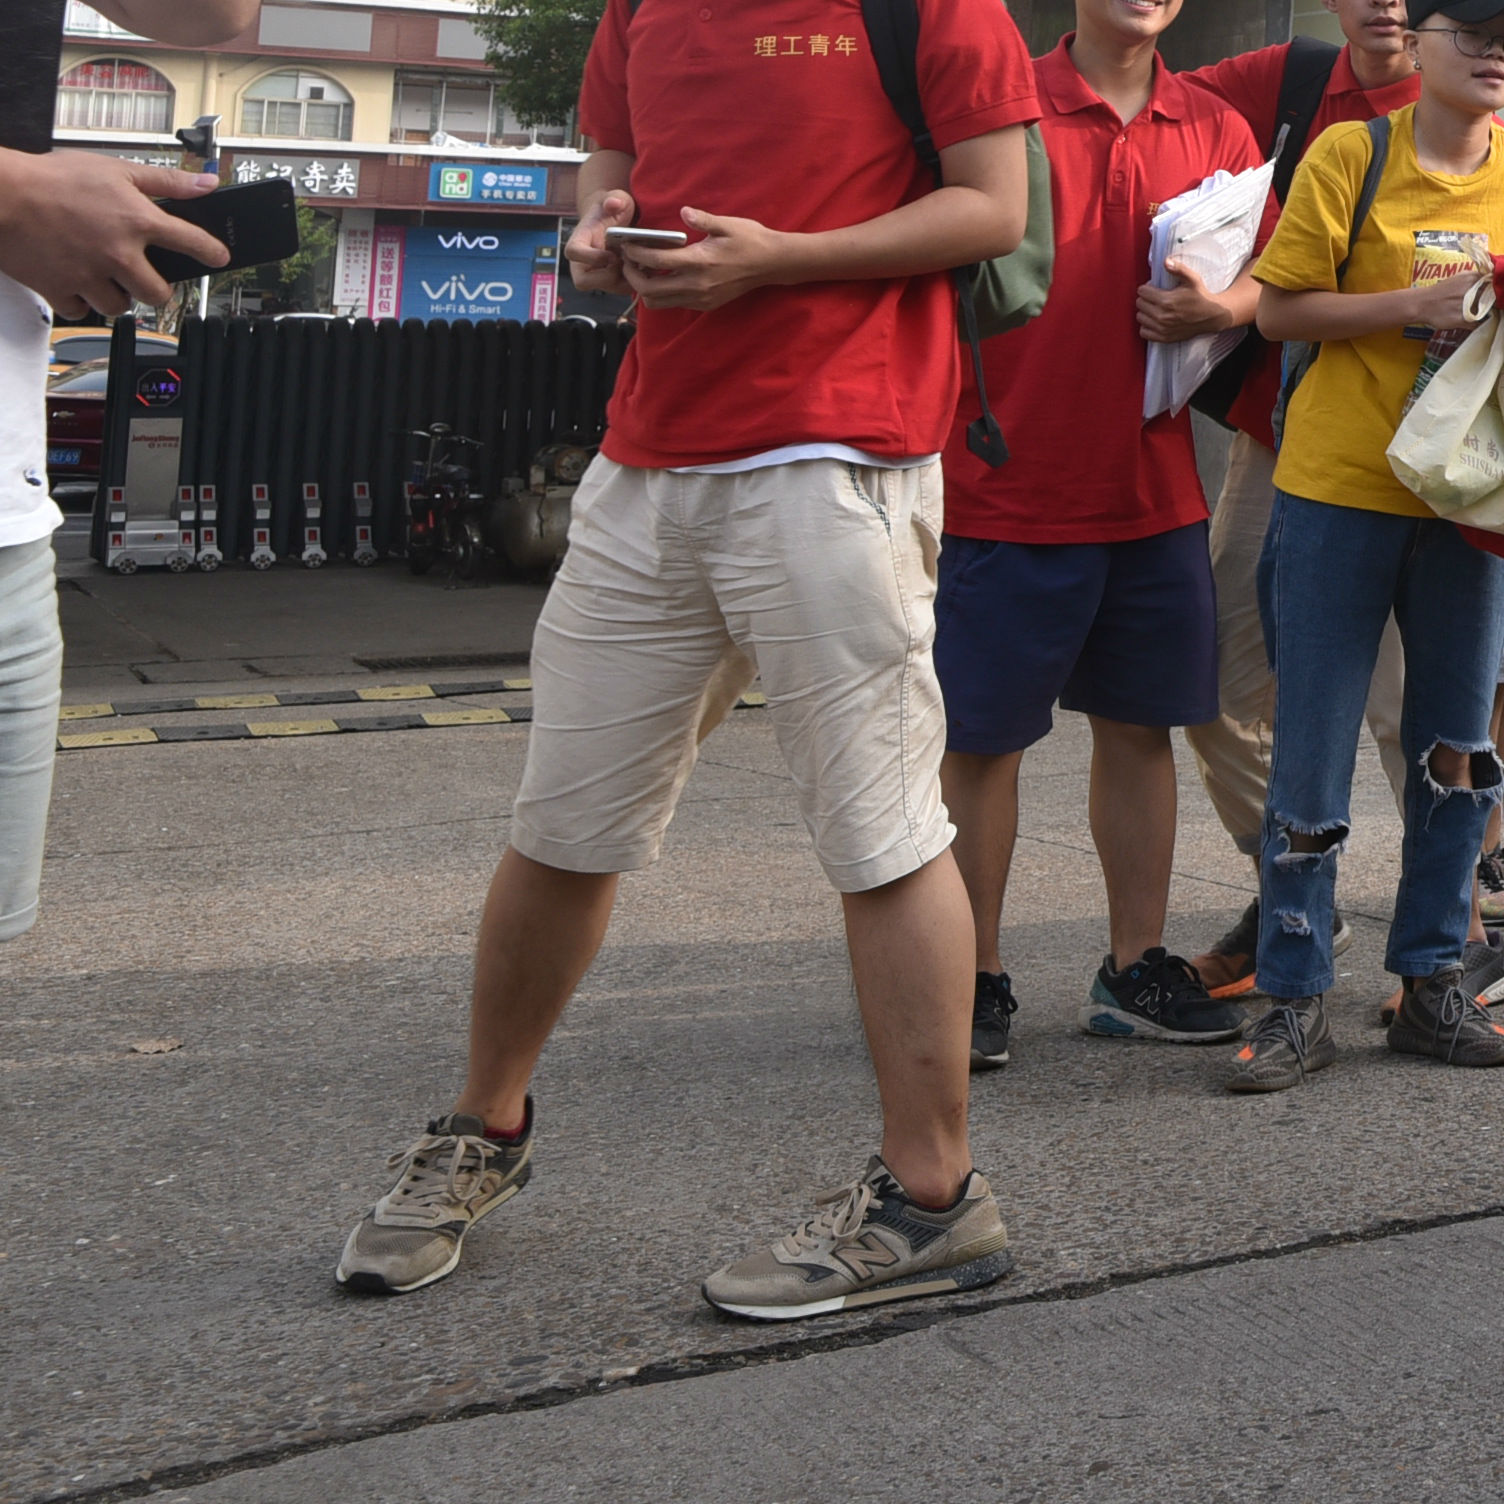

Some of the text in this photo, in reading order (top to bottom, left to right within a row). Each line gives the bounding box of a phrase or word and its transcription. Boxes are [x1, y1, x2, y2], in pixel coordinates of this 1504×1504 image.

[754, 33, 858, 57] 理工青年
[235, 158, 358, 196] 熊记寄卖
[438, 232, 499, 250] vivo
[378, 247, 395, 313] 送等额红包
[421, 274, 513, 301] vivo
[430, 304, 501, 315] Hi-Fi & Smart
